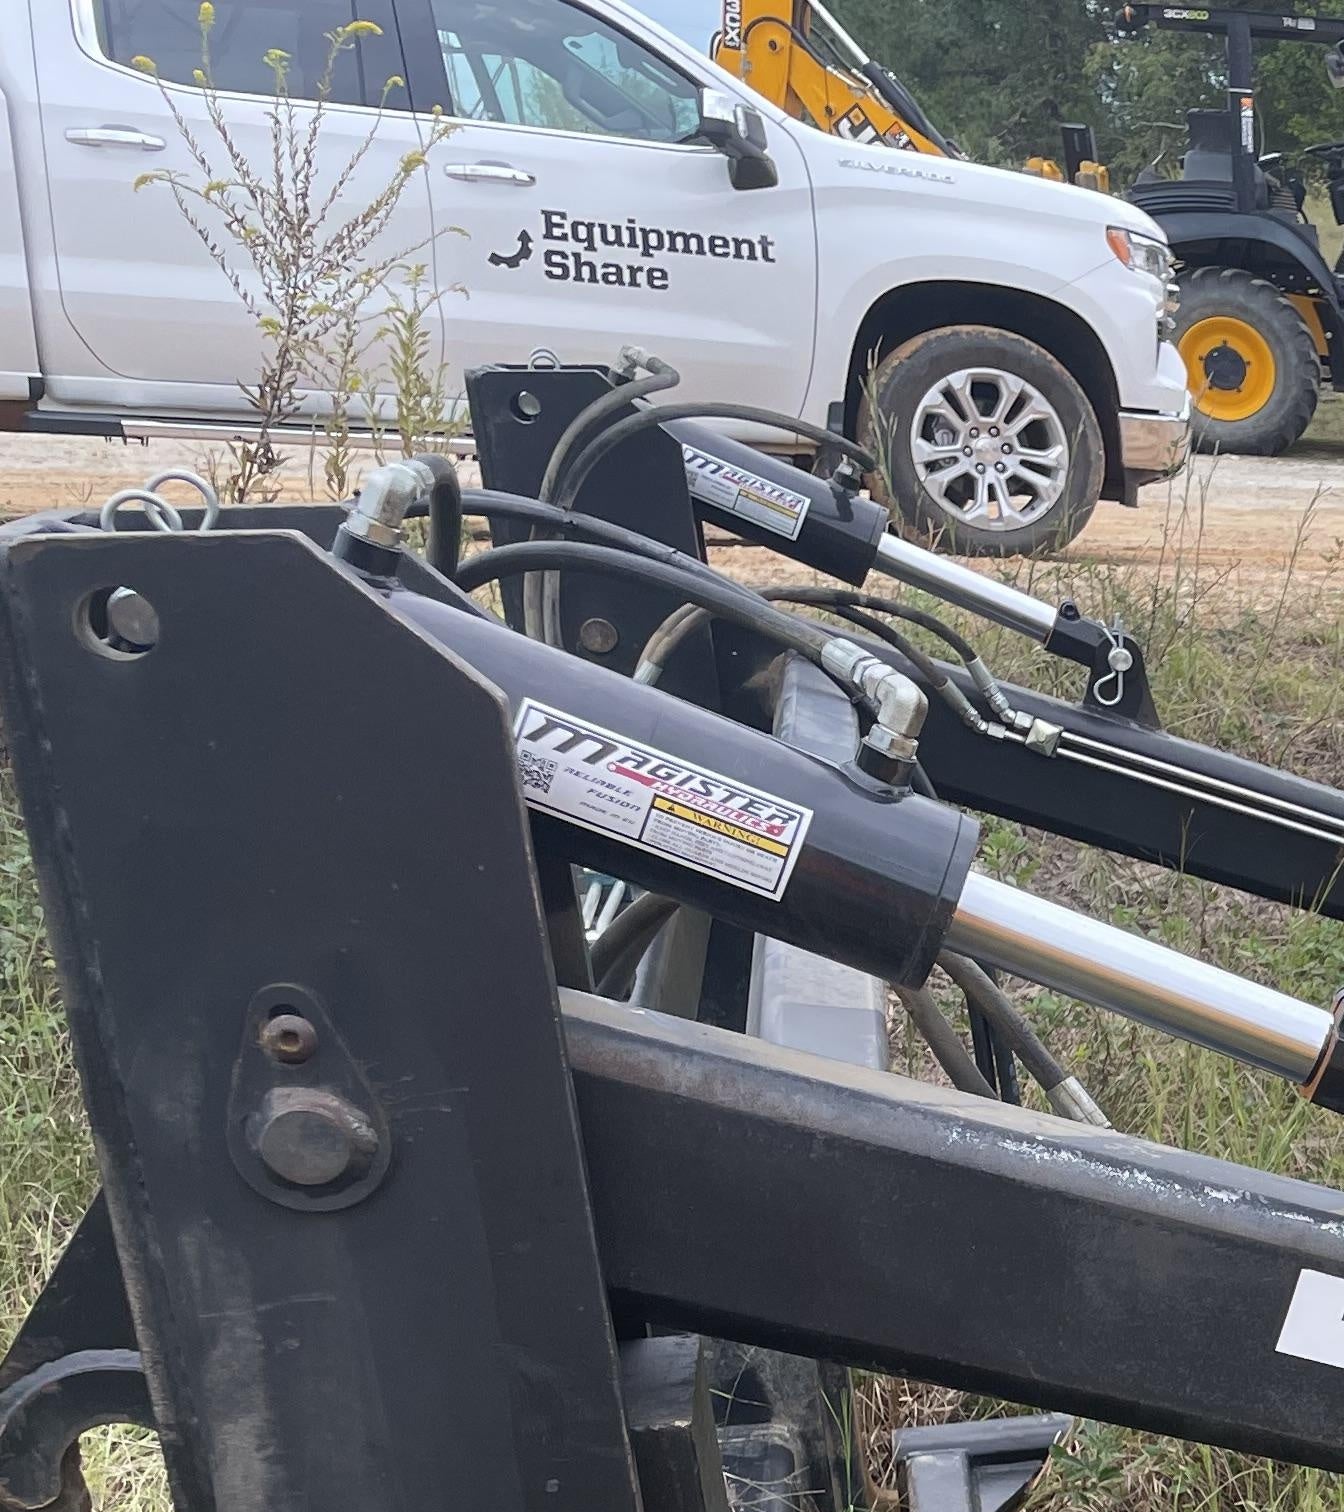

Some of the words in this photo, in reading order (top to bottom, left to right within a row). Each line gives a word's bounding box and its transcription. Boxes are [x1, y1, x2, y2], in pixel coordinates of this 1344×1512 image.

[540, 209, 776, 262] Equipment
[544, 249, 669, 290] Share
[523, 717, 797, 825] MAGISTER
[564, 767, 634, 796] RELIABLE
[587, 788, 641, 811] FUSION
[652, 782, 768, 831] HYDRAULICS
[694, 812, 761, 845] WARNING!
